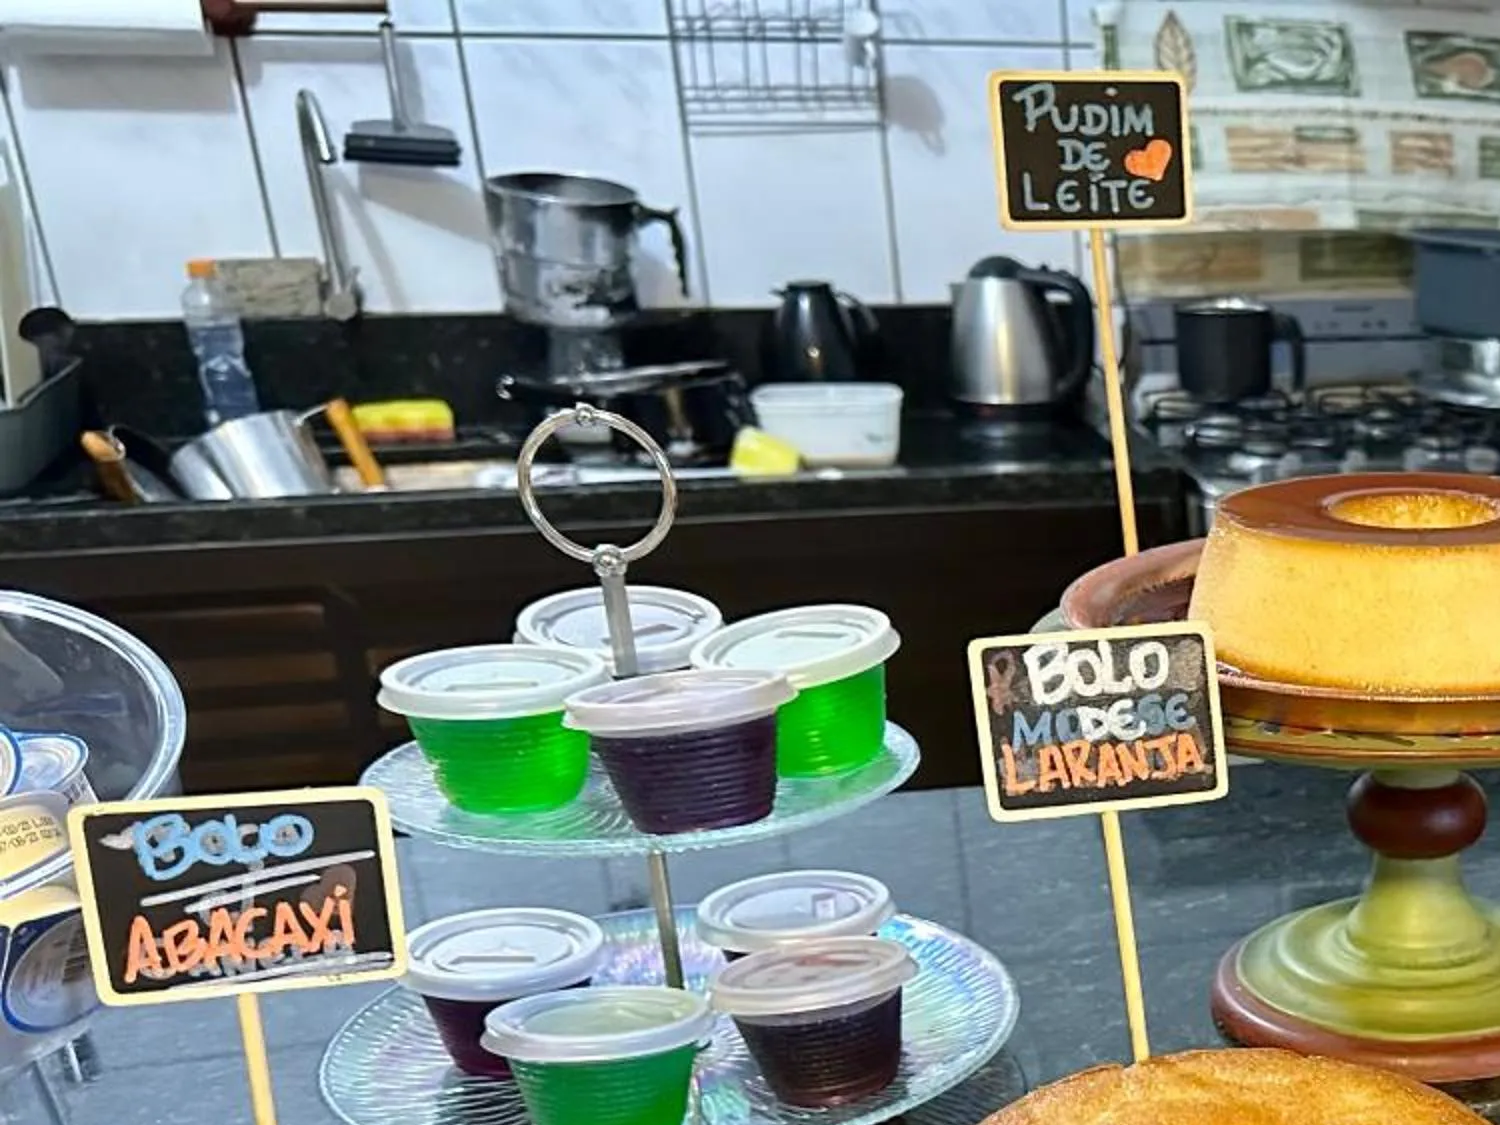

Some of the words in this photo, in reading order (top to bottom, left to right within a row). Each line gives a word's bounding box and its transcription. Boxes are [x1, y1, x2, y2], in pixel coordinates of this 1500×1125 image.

[1057, 138, 1111, 172] DE
[1022, 640, 1170, 704] BOLO
[1000, 733, 1205, 796] LARANJA
